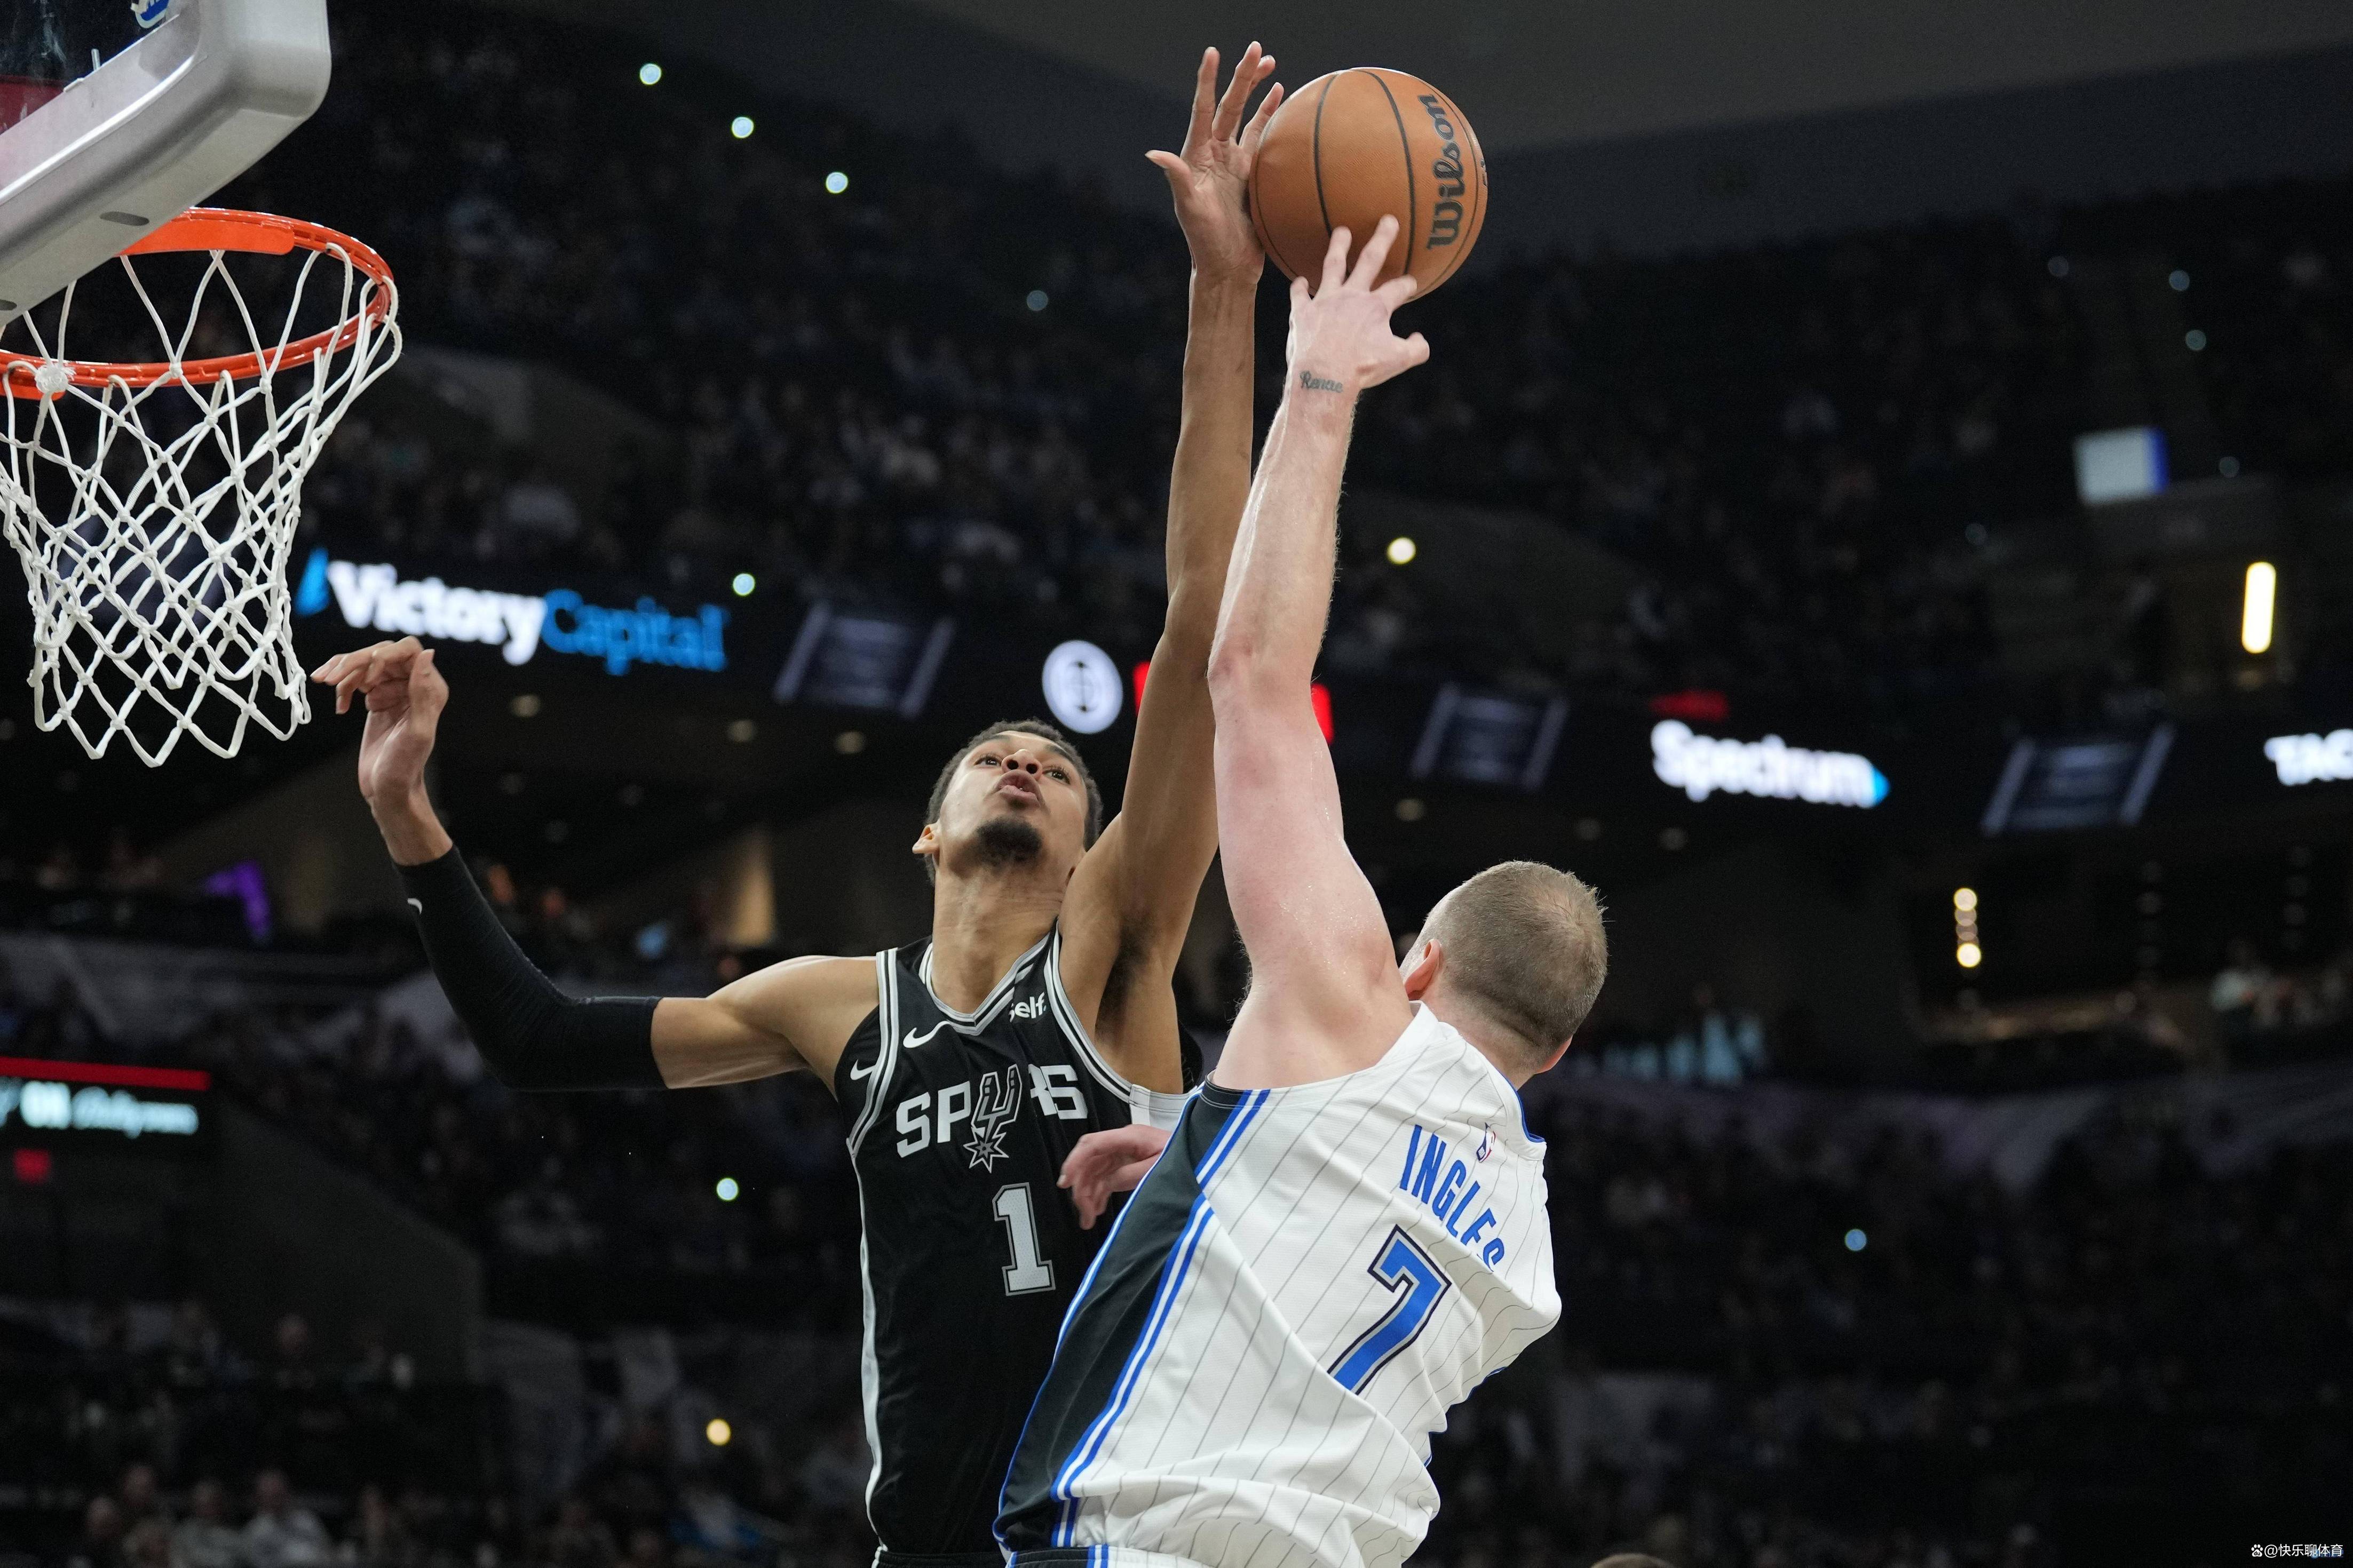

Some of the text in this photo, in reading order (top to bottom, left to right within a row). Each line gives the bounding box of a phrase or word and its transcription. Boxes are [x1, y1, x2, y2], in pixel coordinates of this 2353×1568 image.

[1417, 93, 1465, 250] Wilson
[327, 560, 728, 675] Victory Capital
[1651, 720, 1876, 808] Spectrum
[992, 1182, 1056, 1296] 1
[1327, 1223, 1452, 1396] 7
